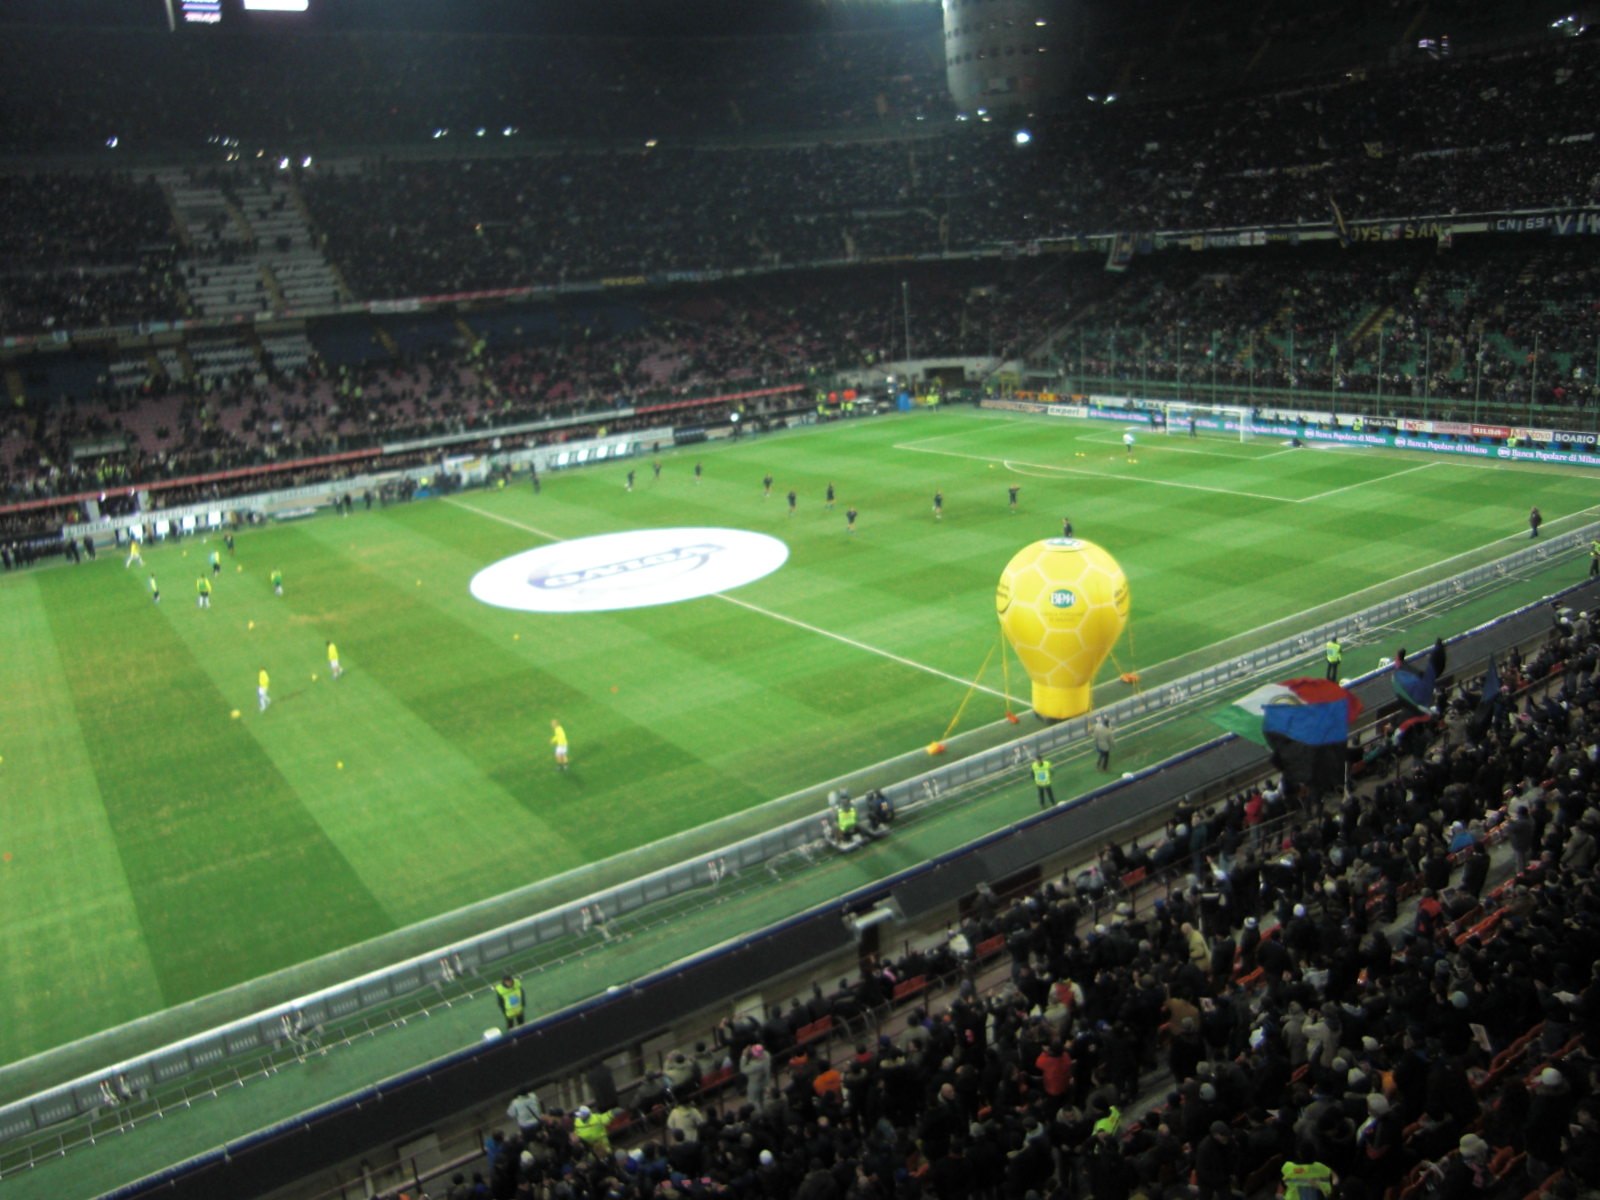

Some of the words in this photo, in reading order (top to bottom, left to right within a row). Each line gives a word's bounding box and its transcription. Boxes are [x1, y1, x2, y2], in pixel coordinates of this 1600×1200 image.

[1555, 434, 1595, 445] BOARIO
[1512, 448, 1535, 459] Banca
[1536, 450, 1568, 462] Popolare
